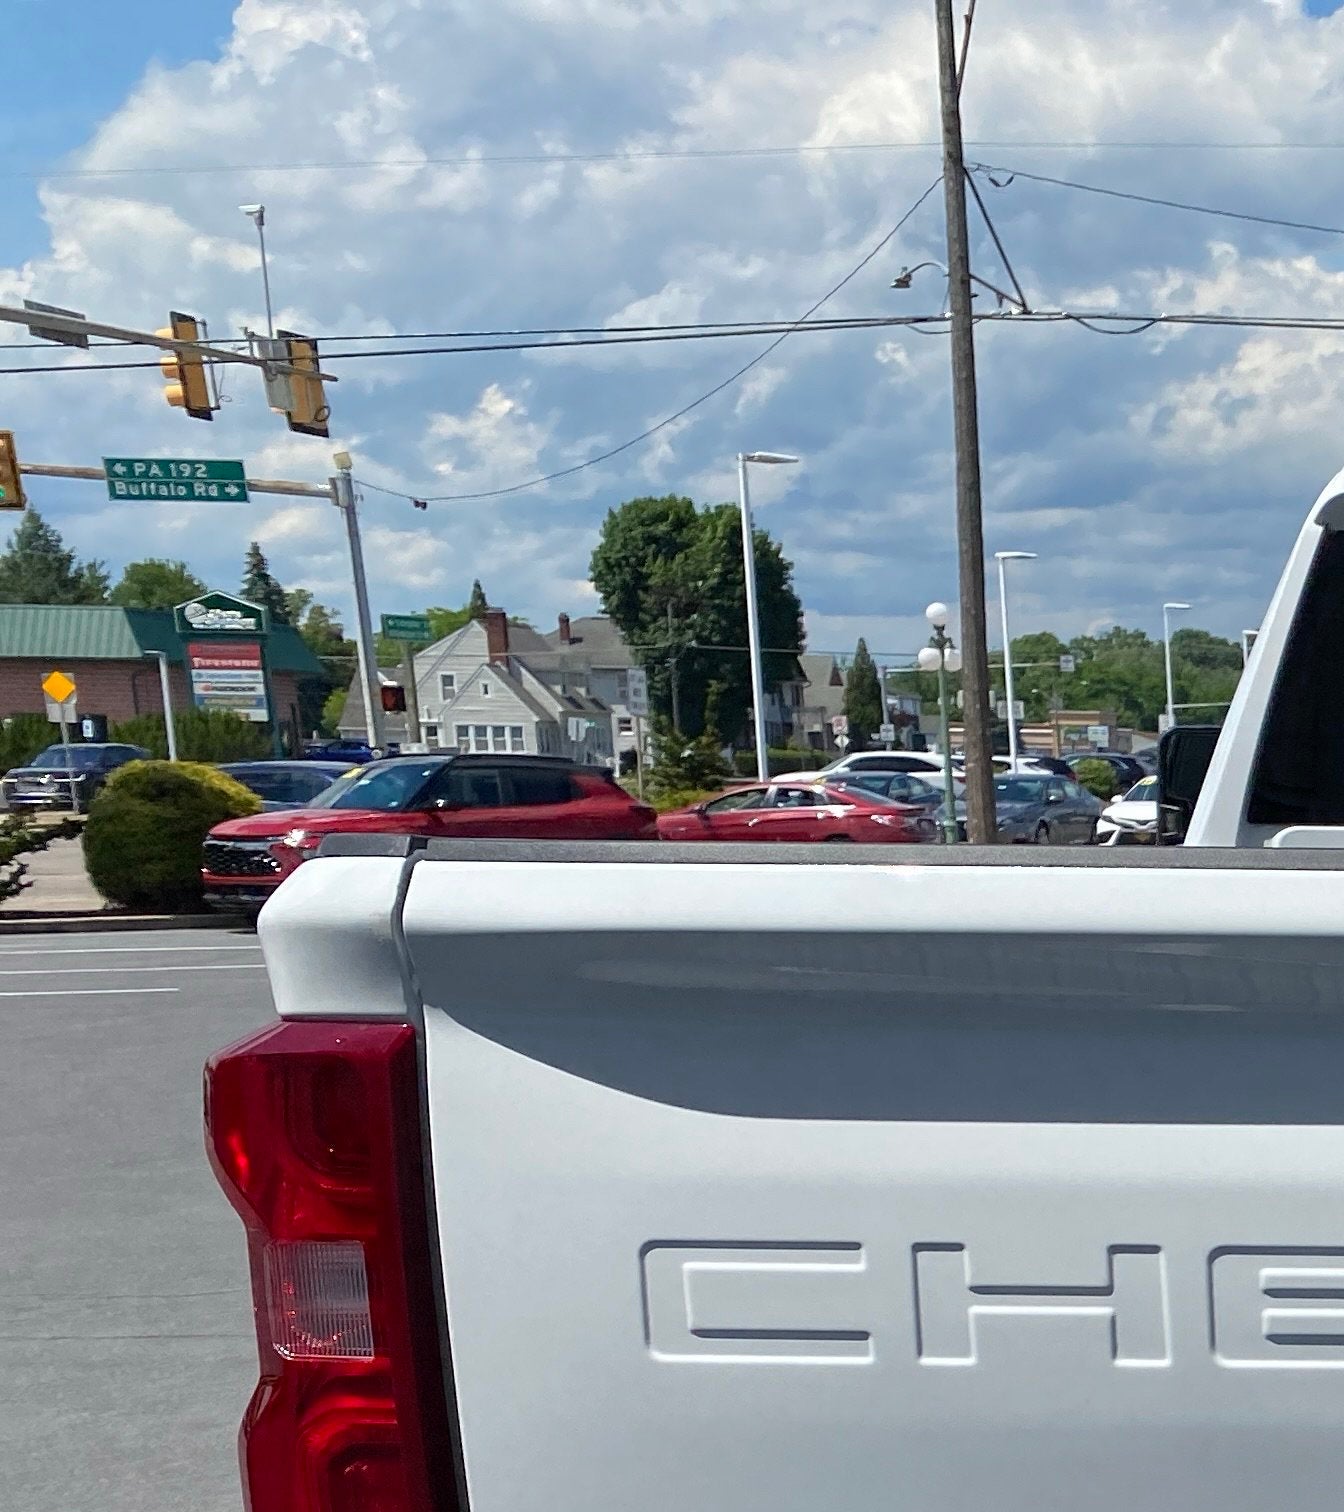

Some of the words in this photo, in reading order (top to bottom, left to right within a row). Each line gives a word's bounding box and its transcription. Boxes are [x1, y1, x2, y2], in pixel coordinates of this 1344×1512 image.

[133, 462, 163, 478] PA
[169, 462, 207, 478] 192
[115, 481, 187, 496] Buffalo
[193, 482, 218, 497] Rd
